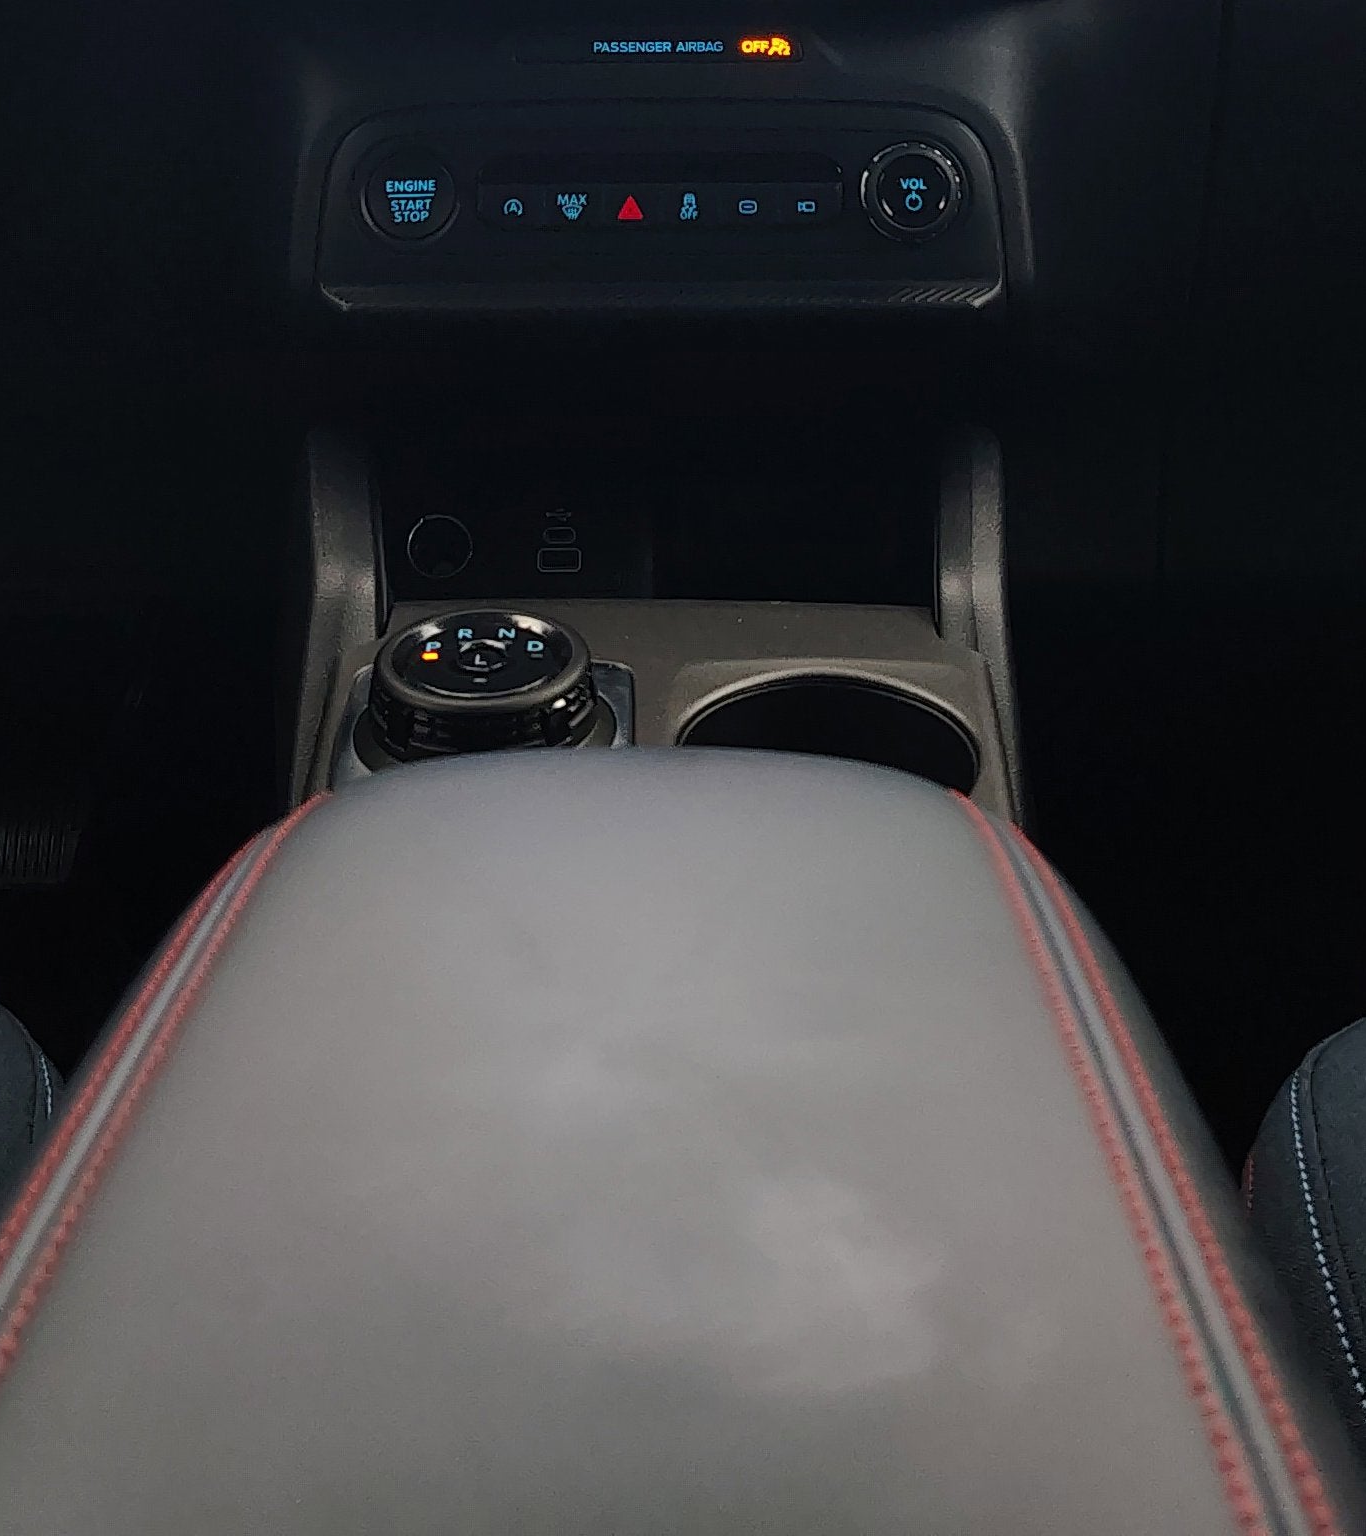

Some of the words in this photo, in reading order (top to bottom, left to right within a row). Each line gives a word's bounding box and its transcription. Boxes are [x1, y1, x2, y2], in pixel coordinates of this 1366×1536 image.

[593, 41, 672, 53] PASSENGER
[676, 41, 724, 53] AIRBAG
[741, 39, 769, 54] OFF
[385, 180, 436, 193] ENGINE
[899, 178, 927, 190] VOL
[391, 199, 432, 212] START
[557, 193, 587, 206] MAX
[394, 211, 429, 223] STOP
[425, 641, 442, 652] P
[457, 628, 473, 639] R
[498, 628, 516, 639] N
[527, 640, 544, 652] D
[475, 653, 488, 666] L
